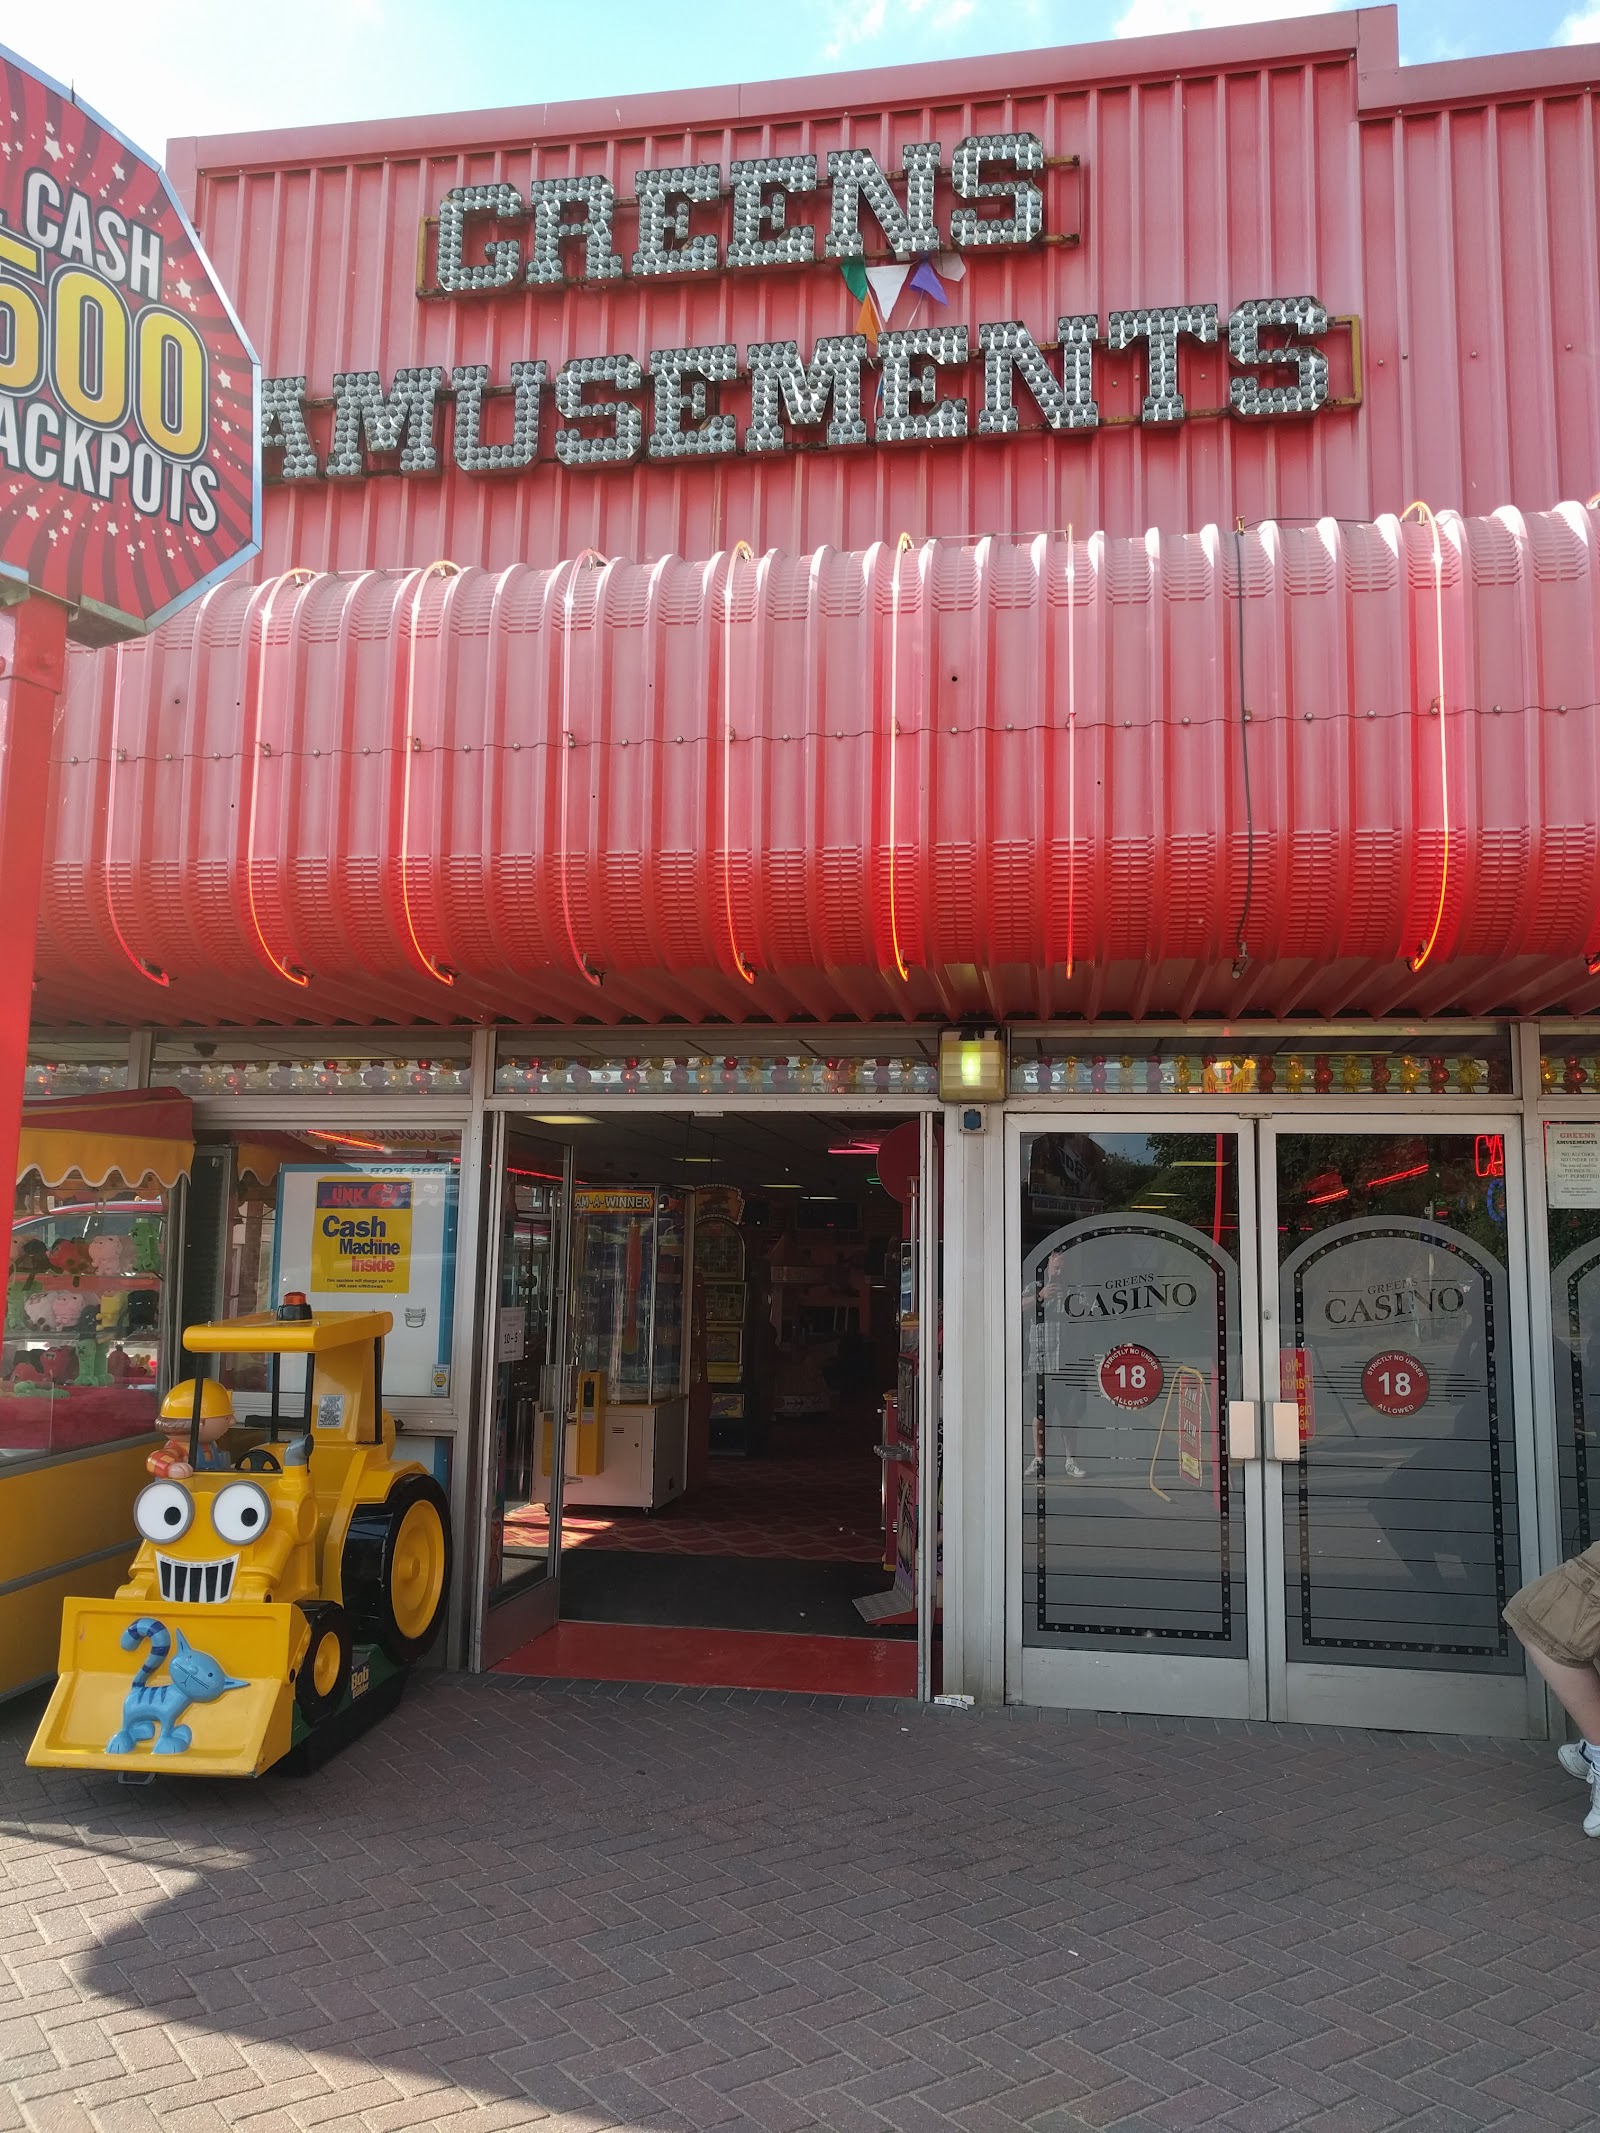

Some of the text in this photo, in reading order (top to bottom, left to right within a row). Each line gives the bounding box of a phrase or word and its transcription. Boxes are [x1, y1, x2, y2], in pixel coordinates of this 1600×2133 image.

[436, 131, 1044, 292] GREENS
[25, 172, 163, 300] CASH
[261, 295, 1330, 480] AMUSEMENTS
[572, 1194, 650, 1209] AM-A-WINNER
[322, 1214, 387, 1237] Cash
[339, 1238, 401, 1255] Machine
[351, 1256, 395, 1273] Inside
[1105, 1273, 1154, 1290] GREENS
[1367, 1279, 1418, 1295] GREENS
[1064, 1283, 1197, 1318] CASINO
[1324, 1287, 1464, 1324] CASINO
[1104, 1348, 1129, 1369] STRICTLY
[1140, 1351, 1159, 1371] UNDER
[1367, 1355, 1393, 1376] STRICTLY
[1405, 1358, 1424, 1378] UNDER
[1114, 1365, 1146, 1389] 18
[1378, 1372, 1411, 1396] 18
[1113, 1395, 1149, 1406] ALLOWED
[1377, 1403, 1414, 1414] ALLOWED
[351, 1665, 369, 1691] Bob
